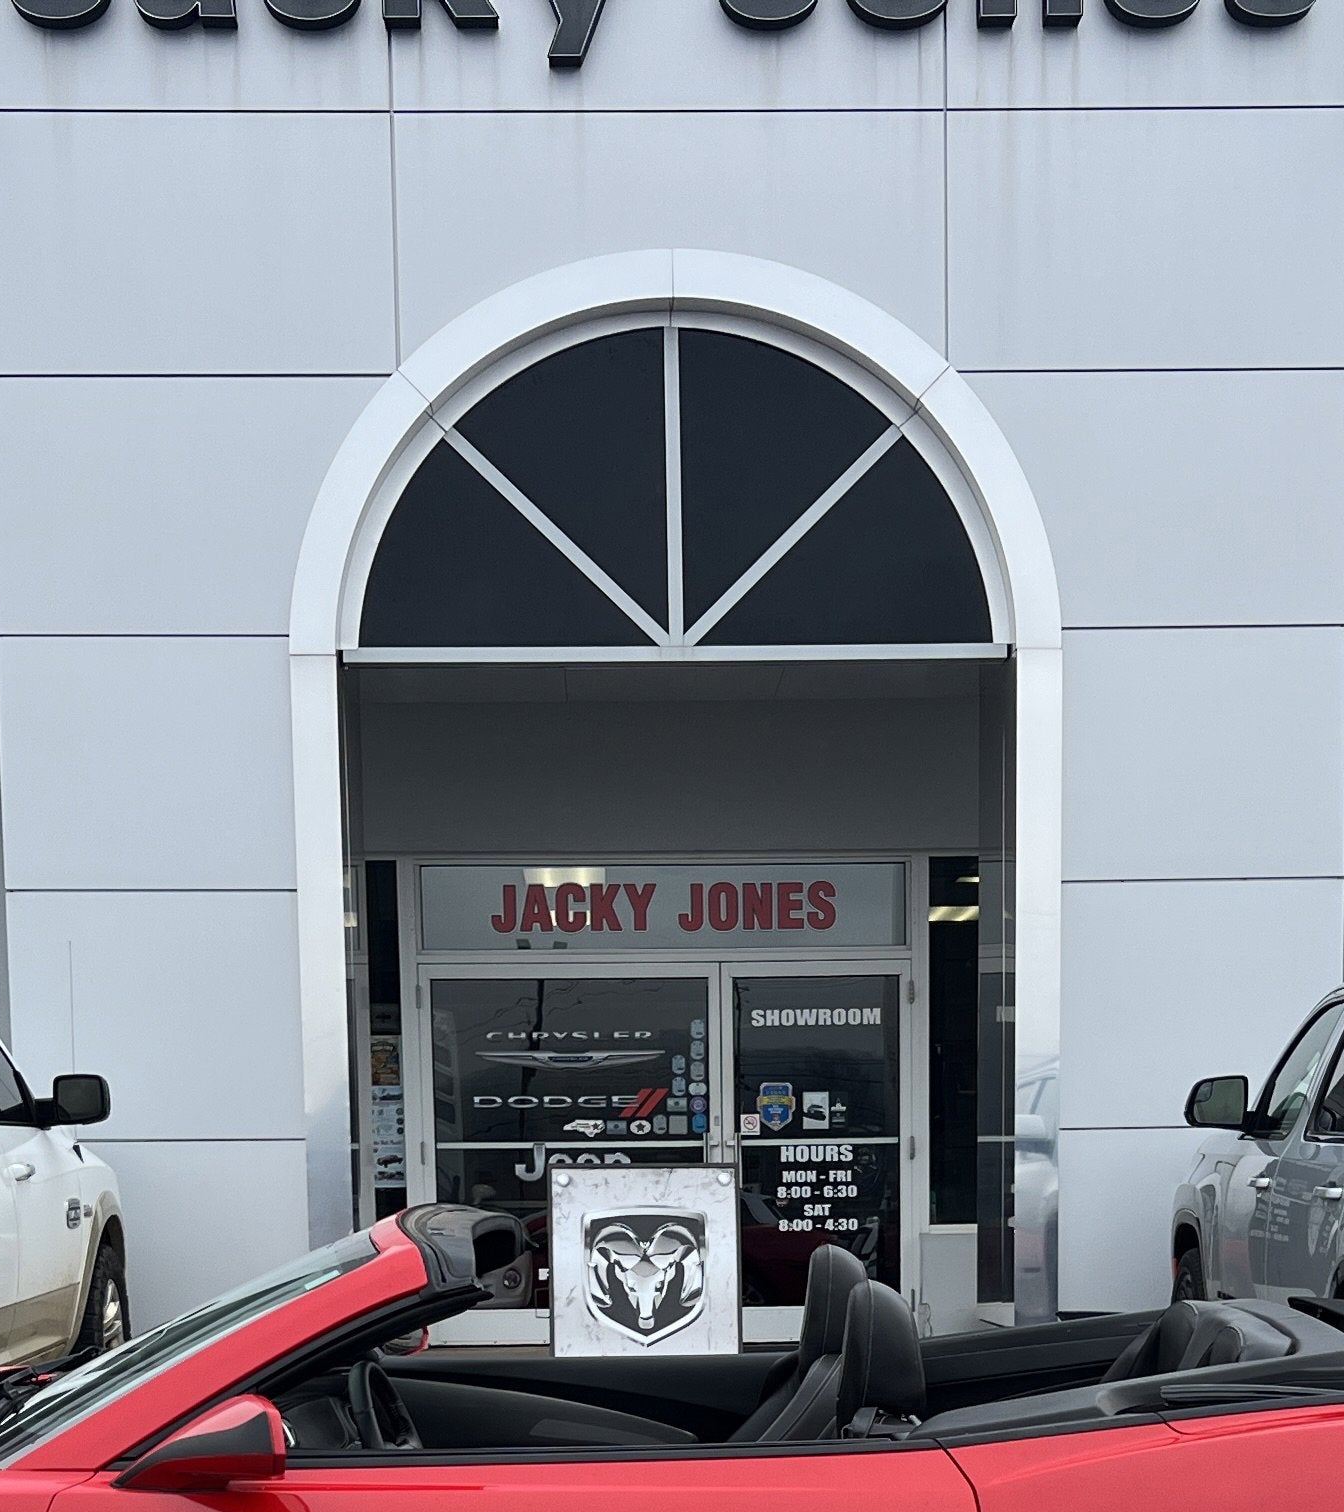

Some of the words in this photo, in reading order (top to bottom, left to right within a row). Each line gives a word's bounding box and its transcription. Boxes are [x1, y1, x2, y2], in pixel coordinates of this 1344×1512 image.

[490, 882, 657, 934] JACKY
[677, 880, 837, 932] JONES
[751, 1008, 881, 1027] SHOWROOM
[486, 1030, 653, 1041] CHRYSLER
[473, 1095, 641, 1109] DODGE
[780, 1145, 853, 1163] HOURS
[782, 1170, 817, 1183] MON
[829, 1170, 852, 1182] FRI
[777, 1186, 811, 1199] 8:00
[823, 1185, 858, 1198] 6:30
[803, 1204, 832, 1217] SAT
[778, 1219, 813, 1232] 8:00
[824, 1218, 859, 1231] 4:30
